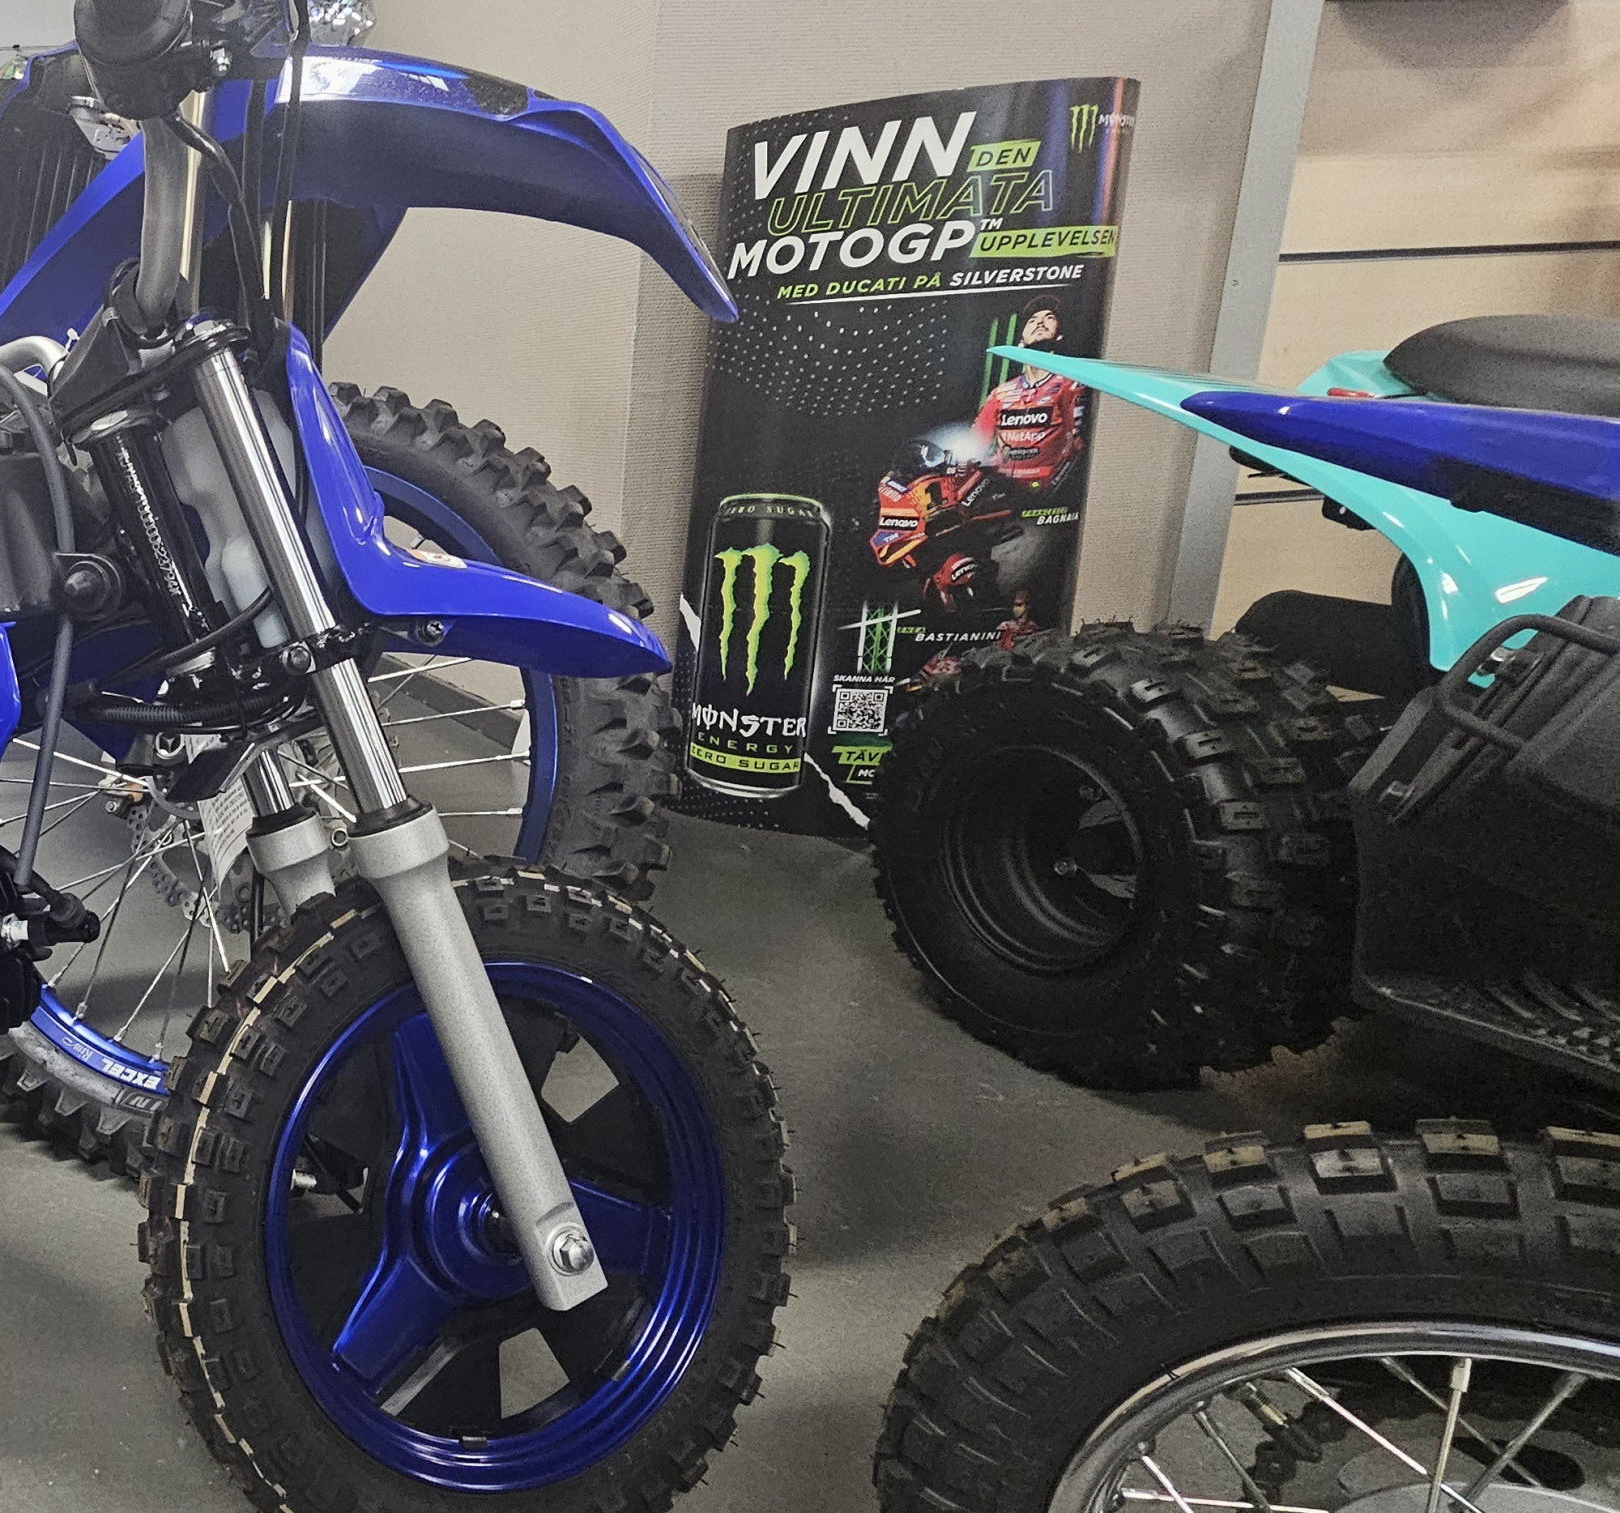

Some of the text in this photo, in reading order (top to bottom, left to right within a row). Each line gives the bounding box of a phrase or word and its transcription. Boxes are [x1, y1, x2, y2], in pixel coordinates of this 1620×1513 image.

[754, 110, 977, 200] VINN
[975, 147, 1032, 168] DEN
[767, 169, 1053, 237] ULTIMATA
[727, 219, 977, 280] MOTOGP
[980, 228, 1114, 252] UPPLEVELSEN
[776, 264, 1085, 300] MED DUCATI PÅ SILVERSTONE
[1000, 412, 1049, 427] Lenovo
[879, 516, 920, 528] Lenovo
[915, 631, 1001, 643] BASTIANINI
[833, 674, 896, 684] SKANNA HÄR
[692, 702, 807, 738] MONSTER
[697, 731, 793, 755] ENERGY
[691, 745, 800, 772] ZERO SUGAR
[102, 1057, 162, 1090] EXCEL
